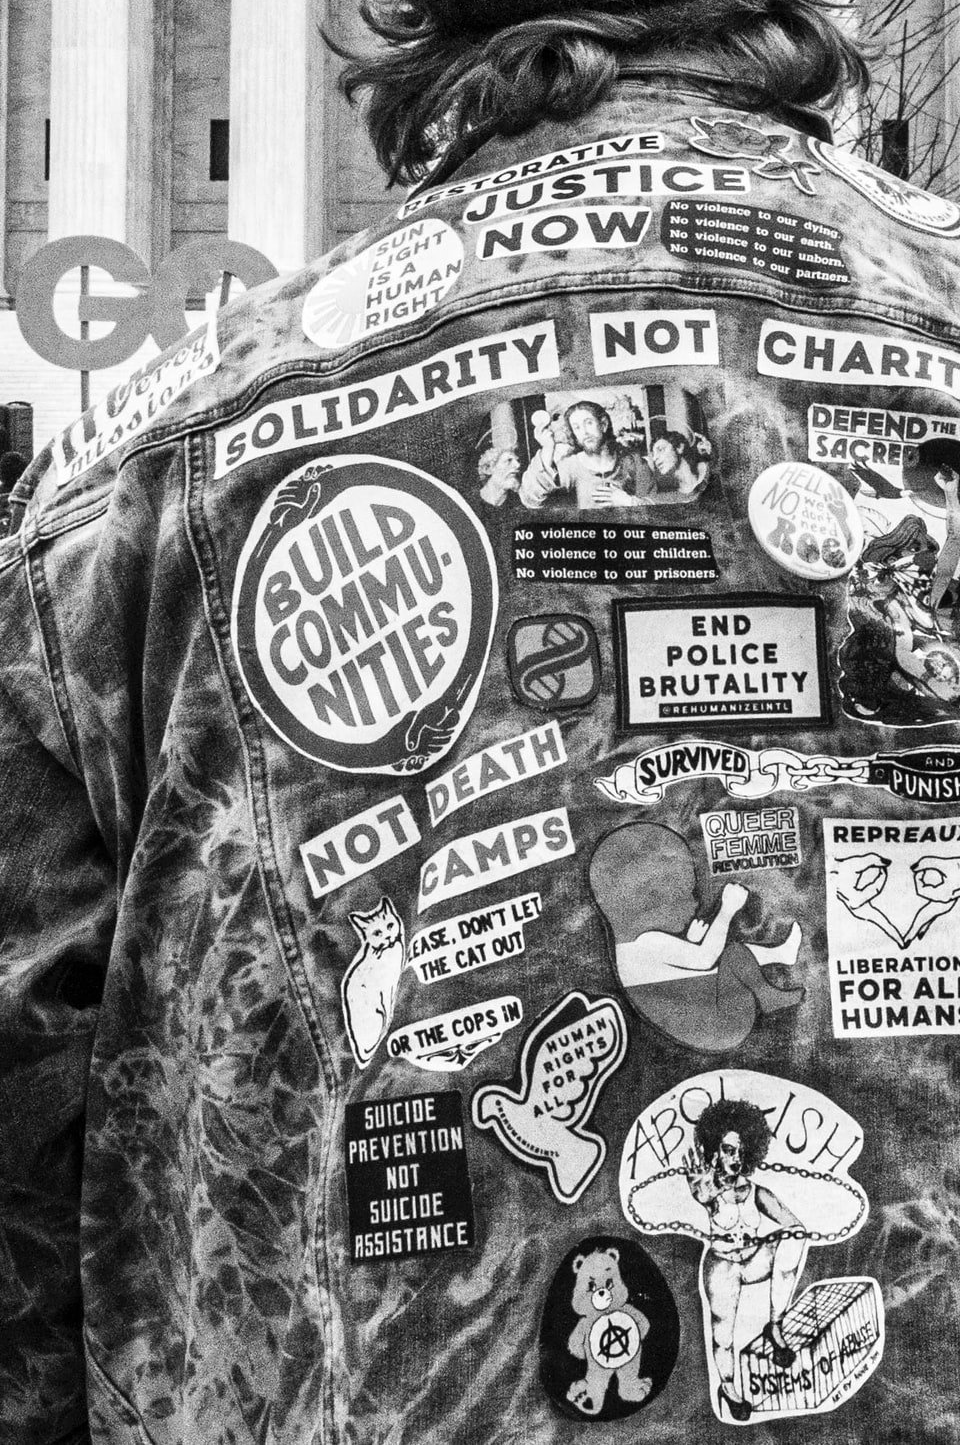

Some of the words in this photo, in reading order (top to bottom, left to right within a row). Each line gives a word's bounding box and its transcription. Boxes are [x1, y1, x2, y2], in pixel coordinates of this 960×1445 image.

[403, 135, 660, 216] RESTORATIVE
[466, 165, 747, 222] JUSTICE
[482, 210, 651, 259] NOW
[670, 201, 689, 211] No
[695, 202, 751, 217] violence
[758, 210, 771, 221] to
[776, 215, 798, 227] our
[803, 220, 841, 240] dying.
[670, 215, 688, 225] No
[695, 217, 750, 233] violence
[755, 226, 769, 237] to
[774, 232, 794, 243] our
[800, 237, 835, 251] earth.
[372, 229, 447, 272] LIGHT
[376, 223, 424, 256] SUN
[669, 229, 688, 239] No
[695, 231, 749, 248] violence
[754, 241, 767, 252] to
[772, 246, 793, 258] our
[798, 251, 845, 268] unborn.
[368, 271, 391, 289] IS
[400, 261, 416, 277] A
[670, 243, 689, 254] No
[694, 246, 747, 263] violence
[752, 257, 766, 268] to
[770, 262, 791, 274] our
[795, 267, 851, 283] partners.
[366, 259, 462, 309] HUMAN
[365, 286, 445, 330] RIGHT
[224, 334, 548, 466] SOLIDARITY
[603, 318, 712, 358] NOT
[812, 406, 928, 441] DEFEND
[931, 420, 957, 435] THE
[815, 435, 919, 468] SACRED
[779, 464, 823, 496] HELL
[514, 530, 534, 541] No
[541, 528, 597, 539] violence
[603, 528, 616, 539] to
[623, 529, 646, 539] our
[652, 529, 709, 541] enemies.
[800, 520, 838, 538] need
[263, 504, 416, 626] BUILD
[515, 548, 535, 559] No
[541, 548, 597, 559] violence
[604, 549, 618, 559] to
[624, 549, 646, 559] our
[653, 548, 711, 559] children.
[516, 567, 535, 579] No
[542, 567, 598, 579] violence
[604, 568, 618, 579] to
[625, 569, 648, 579] our
[654, 568, 719, 581] prisoners.
[692, 615, 751, 636] END
[307, 601, 459, 727] NITIES
[667, 643, 778, 667] POLICE
[639, 671, 808, 698] BRUTALITY
[662, 702, 789, 715] @REHUMANIZEINTL
[427, 727, 561, 821] DEATH
[639, 747, 747, 786] SURVIVED
[924, 756, 955, 768] AND
[705, 808, 794, 838] QUEER
[306, 803, 409, 889] NOT
[421, 816, 569, 897] CAMPS
[710, 832, 797, 860] FEMME
[711, 853, 799, 874] REVOLUTION
[411, 927, 456, 958] EASE,
[458, 908, 506, 939] DON'T
[512, 896, 541, 922] LET
[420, 956, 451, 981] THE
[455, 943, 487, 969] CAT
[492, 931, 523, 956] OUT
[838, 978, 903, 1003] FOR
[390, 1036, 412, 1057] OR
[414, 1024, 448, 1049] THE
[452, 1010, 498, 1037] COPS
[501, 1002, 521, 1023] IN
[547, 1019, 607, 1054] HUMAN
[543, 1037, 607, 1072] RIGHTS
[542, 1071, 577, 1092] FOR
[364, 1098, 436, 1130] SUICIDE
[533, 1096, 564, 1118] ALL
[349, 1127, 463, 1164] PREVENTION
[386, 1164, 420, 1190] NOT
[370, 1192, 444, 1224] SUICIDE
[355, 1221, 468, 1258] ASSISTANCE
[750, 1369, 812, 1395] SYSTEMS
[820, 1350, 837, 1375] OF
[841, 1322, 874, 1362] ABUSE
